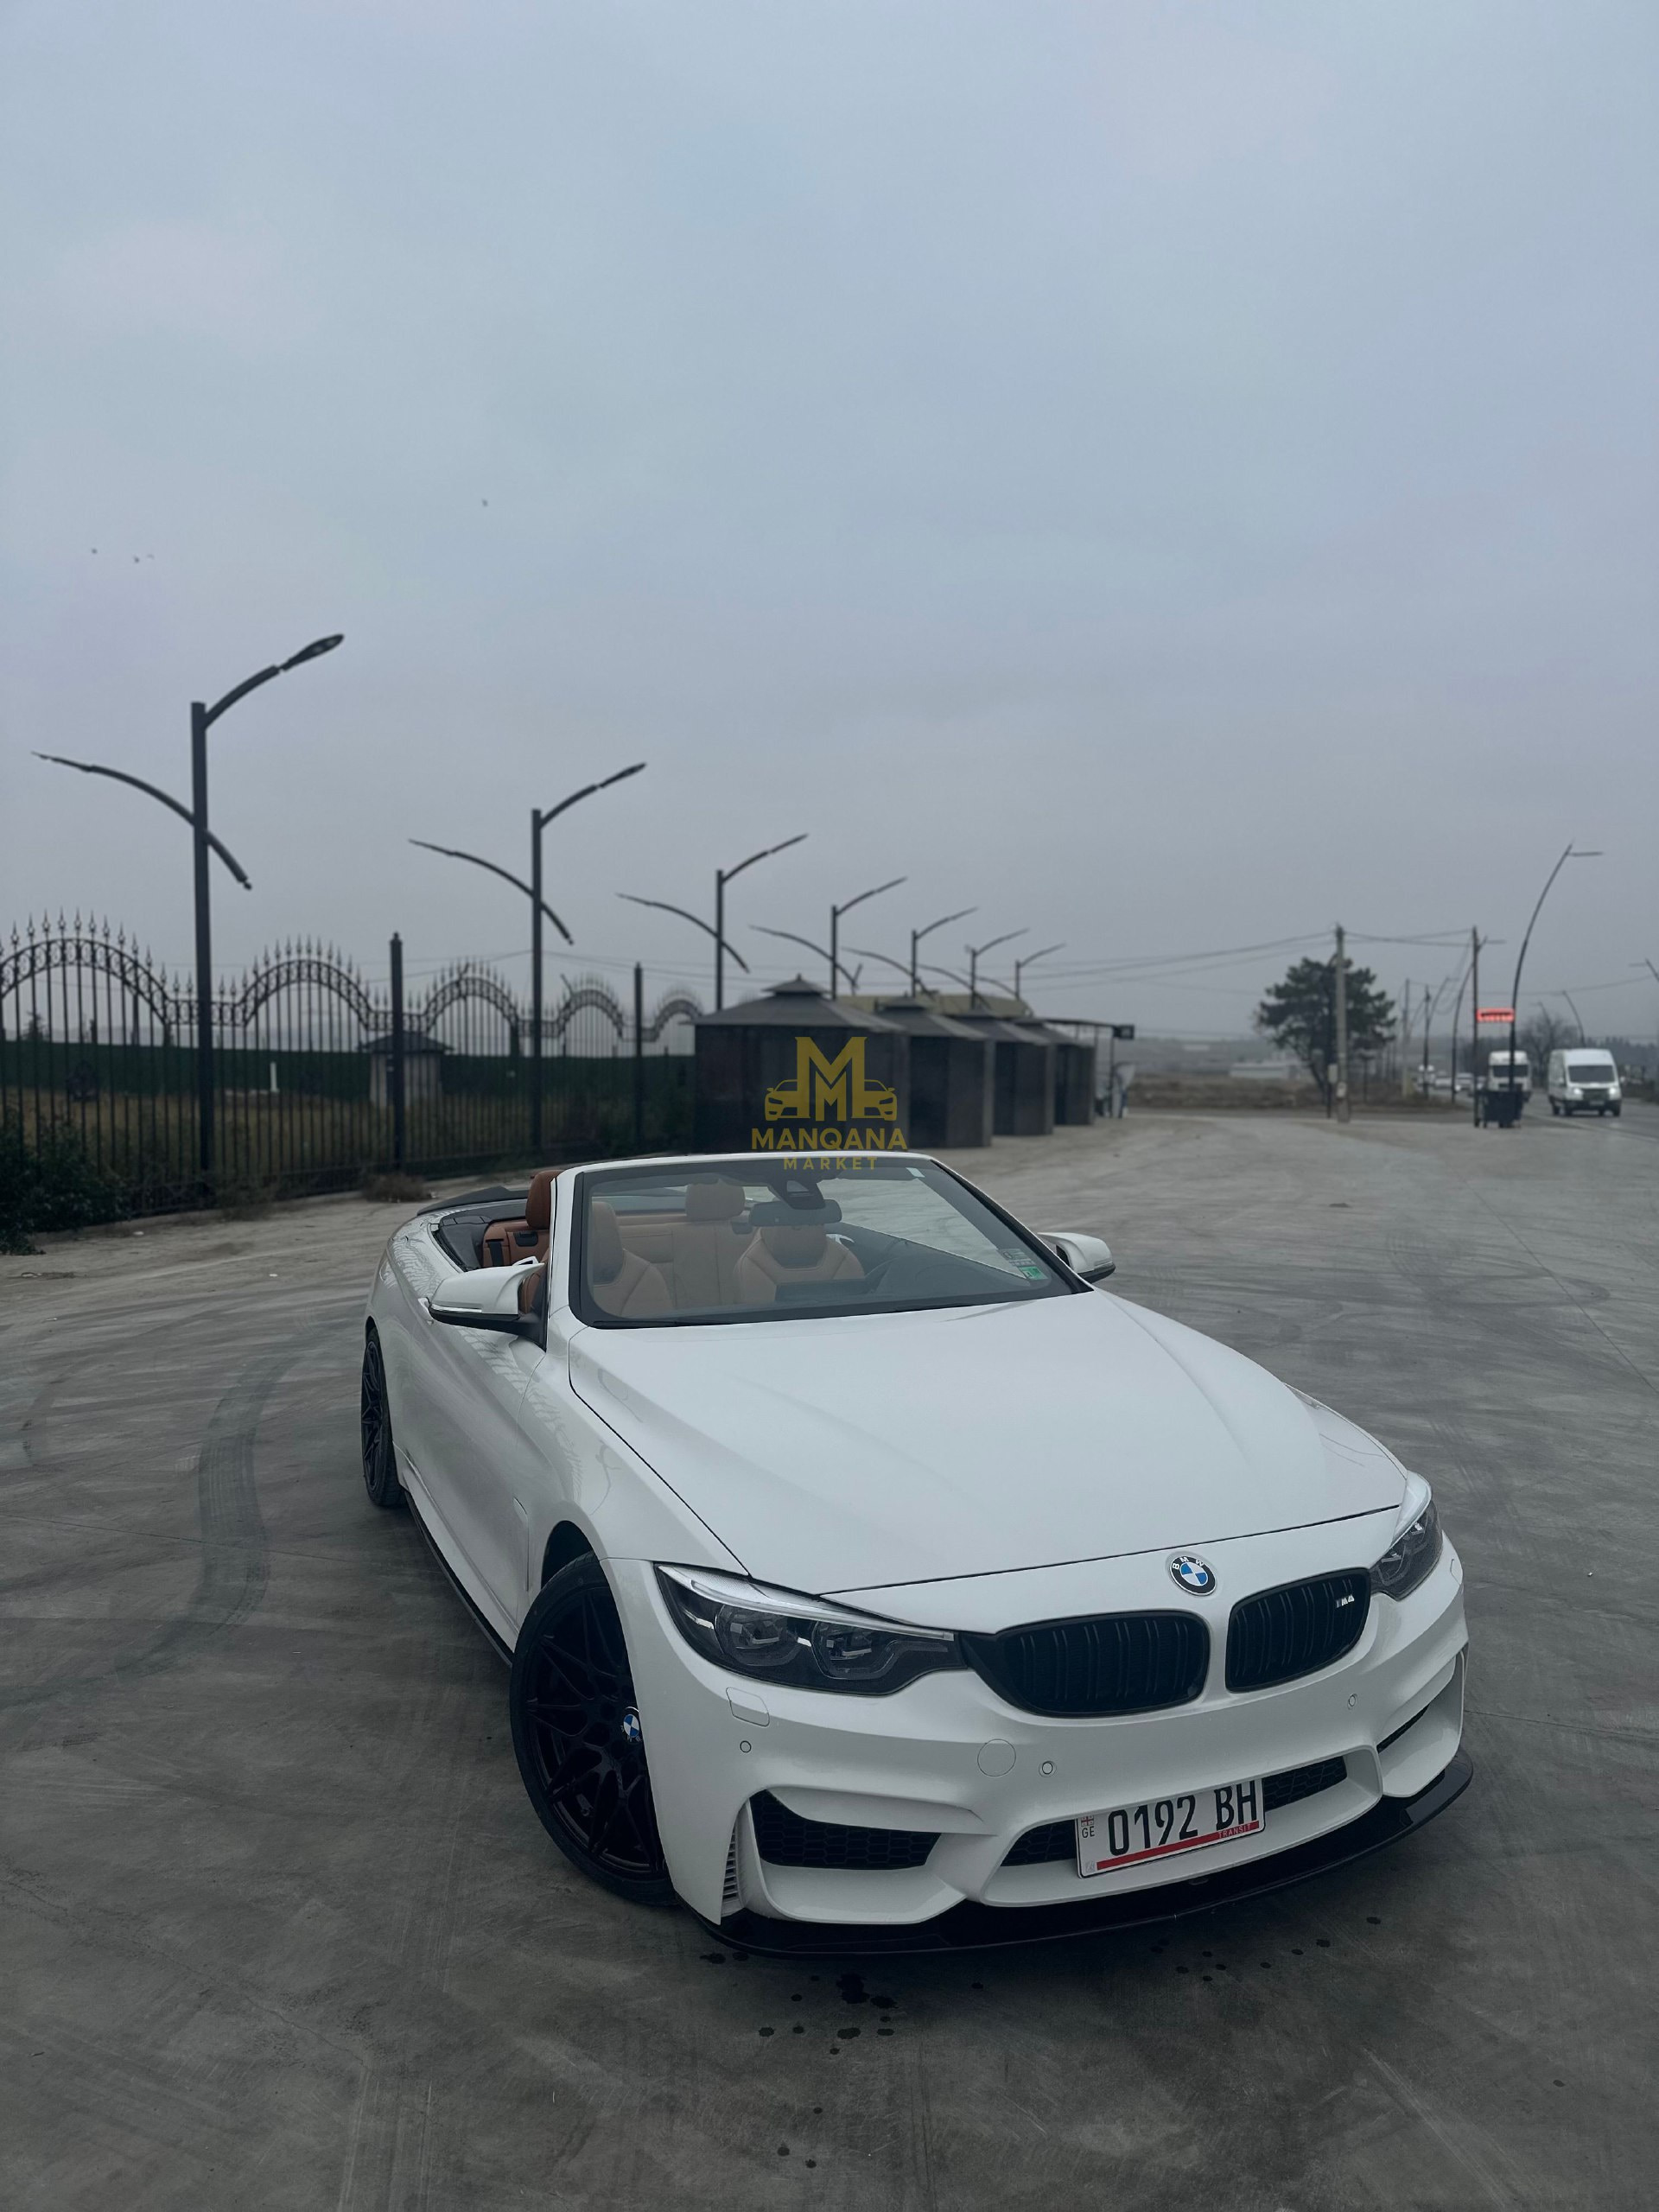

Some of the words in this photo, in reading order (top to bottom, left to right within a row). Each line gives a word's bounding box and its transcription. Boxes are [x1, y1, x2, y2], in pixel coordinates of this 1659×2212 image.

[1172, 1556, 1205, 1570] BMW
[1108, 1795, 1198, 1856] 0192
[1214, 1780, 1257, 1831] BH
[1081, 1825, 1096, 1839] GE
[1217, 1823, 1251, 1839] TRANSIT
